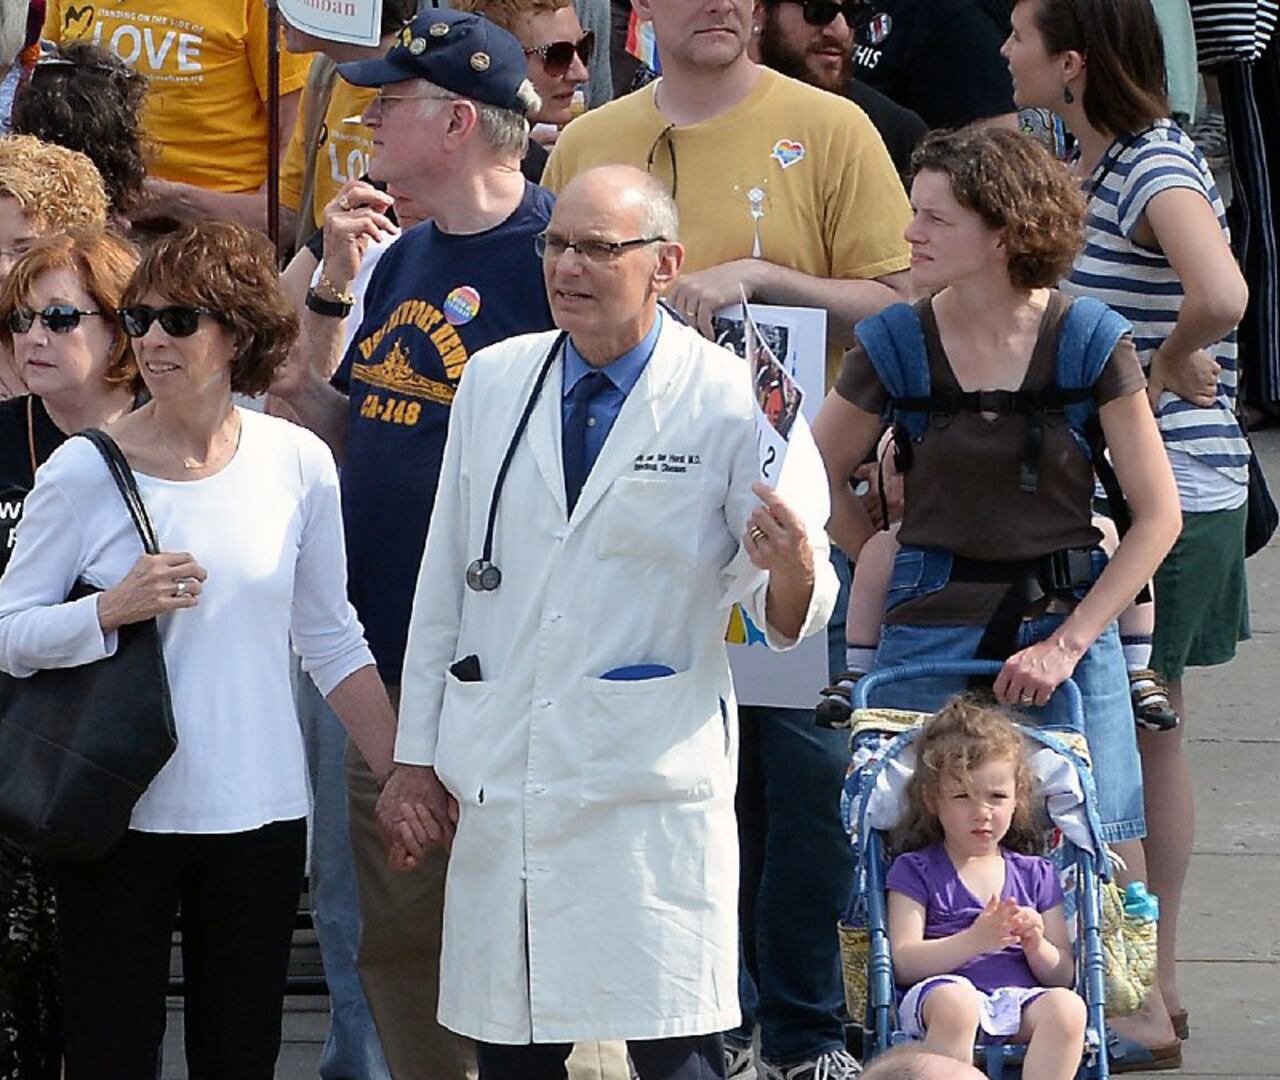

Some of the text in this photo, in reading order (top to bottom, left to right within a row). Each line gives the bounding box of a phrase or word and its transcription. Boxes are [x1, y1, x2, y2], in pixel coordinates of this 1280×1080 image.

[851, 44, 882, 69] HIS
[360, 394, 422, 426] CA-148
[762, 445, 777, 479] 2
